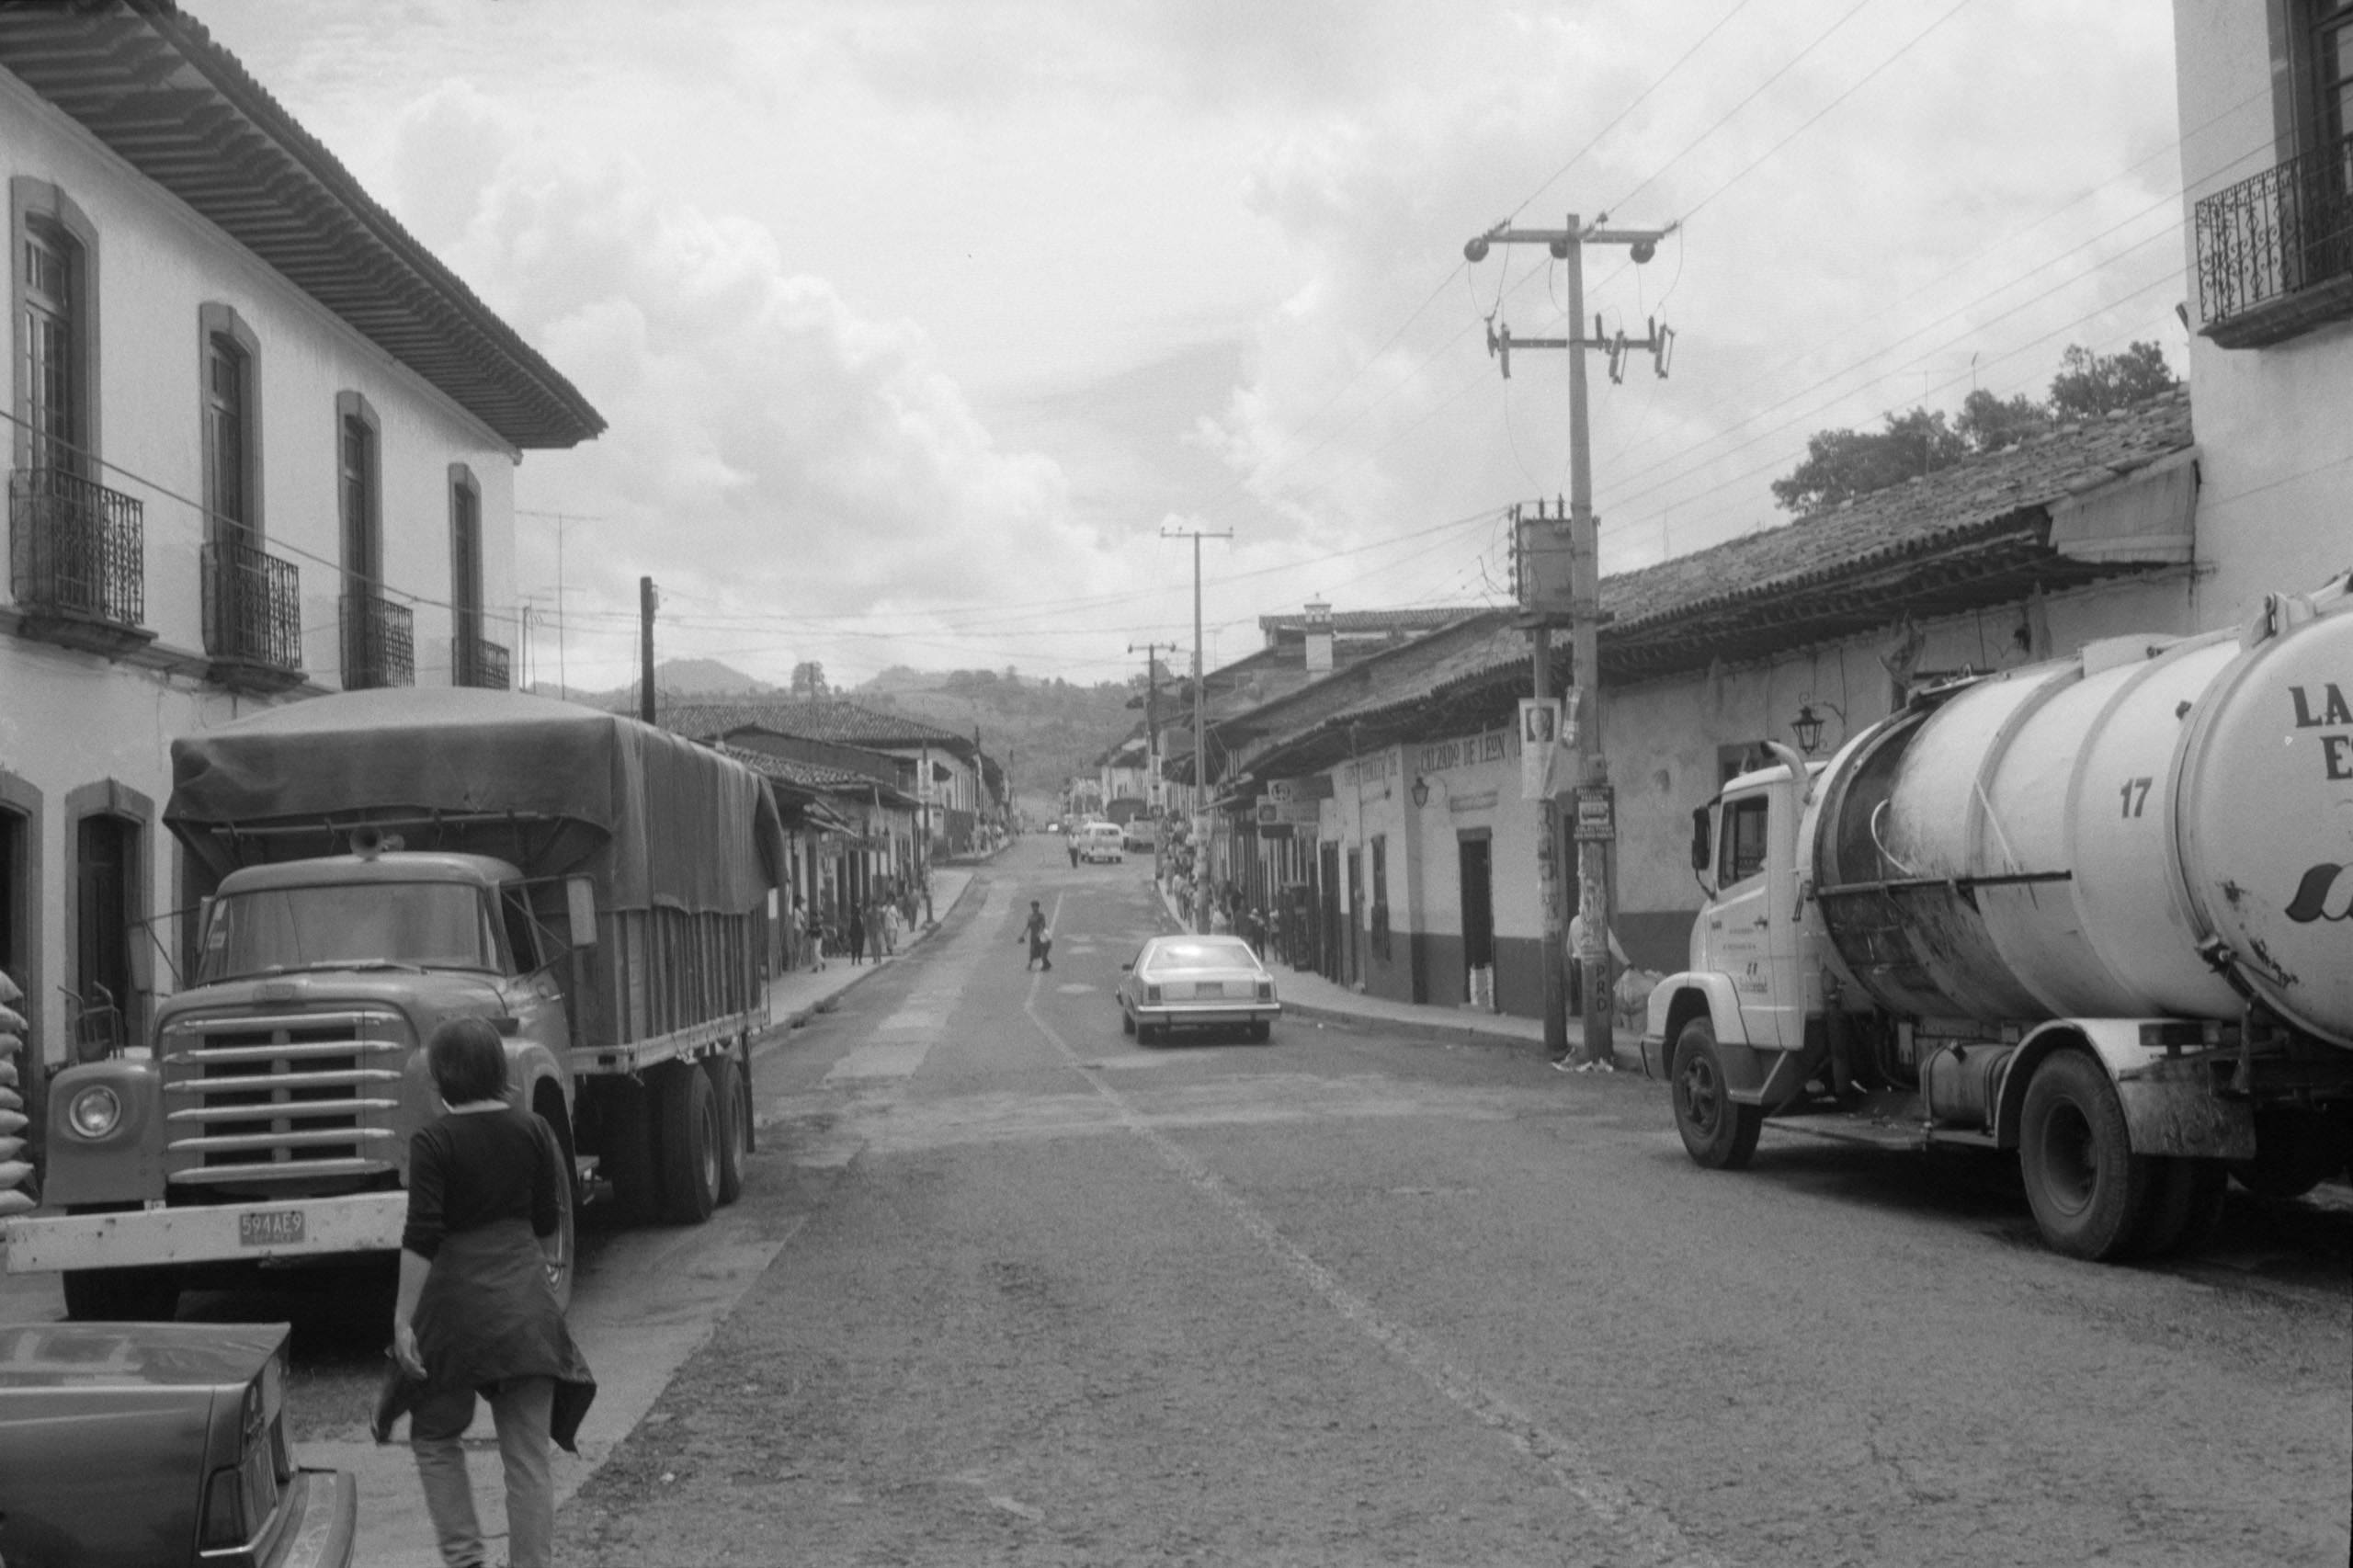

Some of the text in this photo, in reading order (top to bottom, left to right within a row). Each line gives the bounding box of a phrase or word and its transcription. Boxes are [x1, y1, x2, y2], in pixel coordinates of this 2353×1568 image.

[1420, 739, 1460, 773] CALZADO
[1463, 737, 1475, 766] DE
[1479, 733, 1506, 762] LEON
[2319, 734, 2353, 780] E
[2120, 777, 2153, 818] 17
